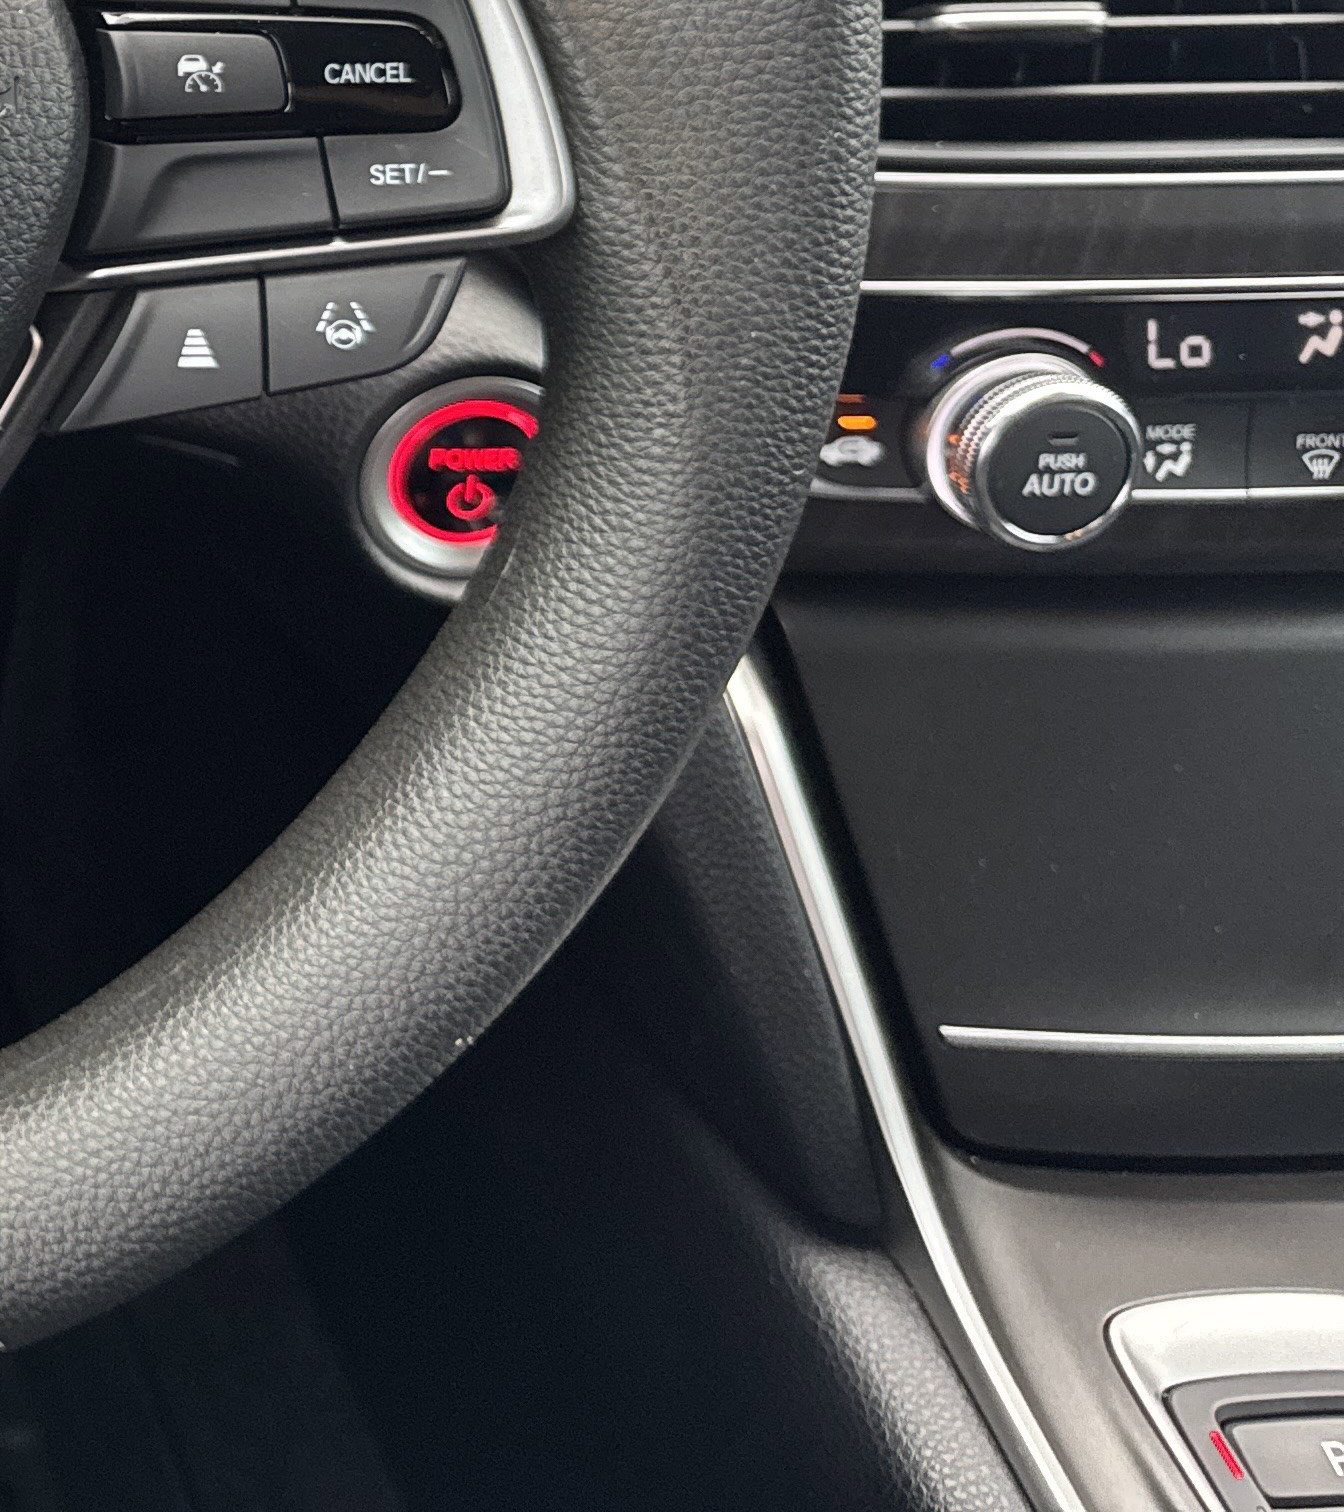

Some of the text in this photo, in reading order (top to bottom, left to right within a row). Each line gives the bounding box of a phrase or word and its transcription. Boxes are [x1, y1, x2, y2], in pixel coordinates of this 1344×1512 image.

[324, 61, 414, 84] CANCEL
[1147, 318, 1211, 369] Lo
[1146, 423, 1197, 440] MODE
[428, 447, 525, 472] POWER
[1038, 452, 1088, 471] PUSH
[1021, 471, 1096, 498] AUTO
